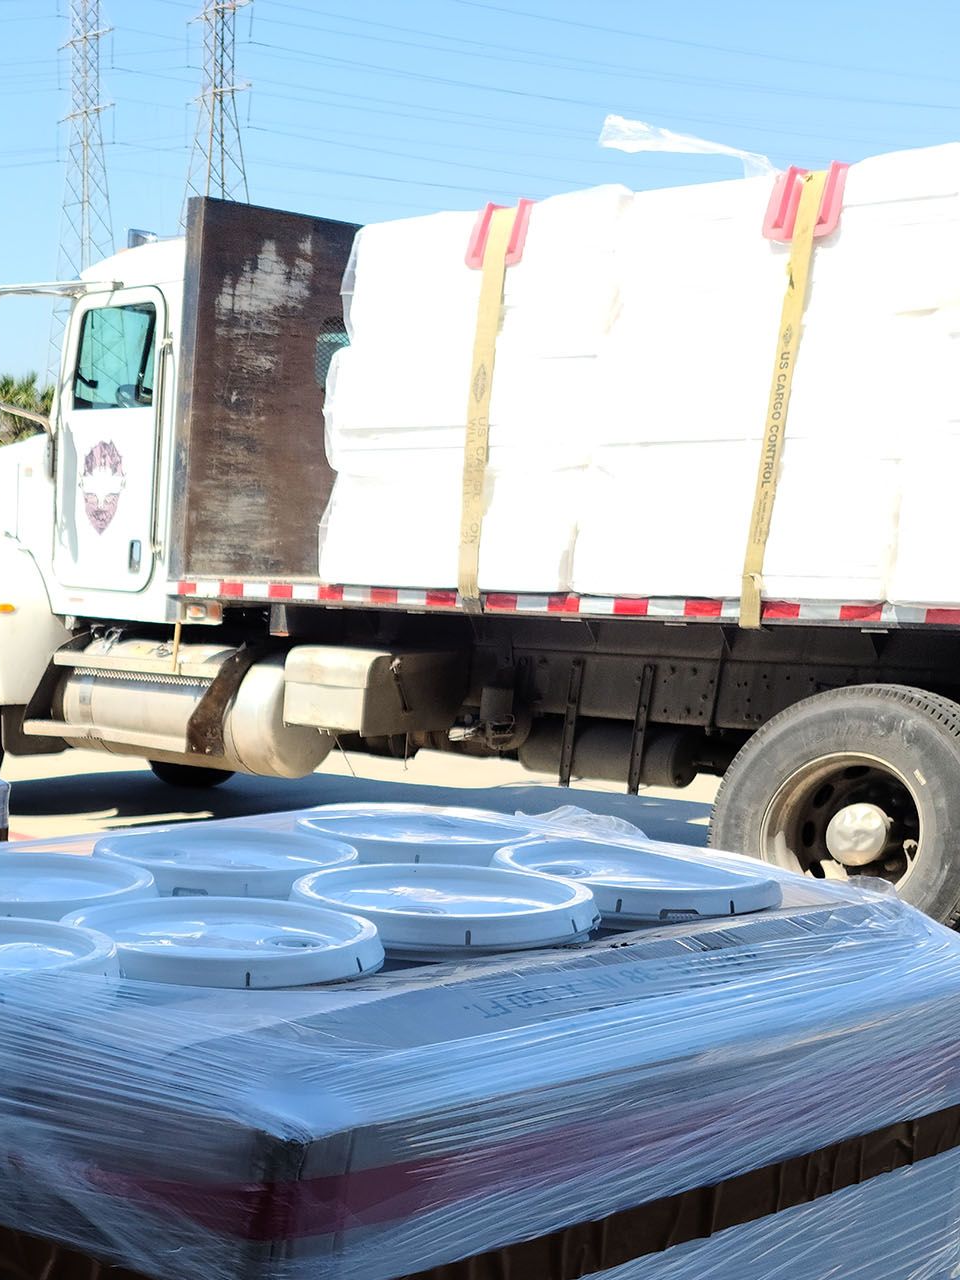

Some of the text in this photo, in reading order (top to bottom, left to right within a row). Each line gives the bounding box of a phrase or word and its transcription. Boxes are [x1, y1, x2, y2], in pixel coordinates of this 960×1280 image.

[778, 351, 791, 370] US
[770, 374, 787, 421] CARGO
[761, 424, 781, 489] CONTROL
